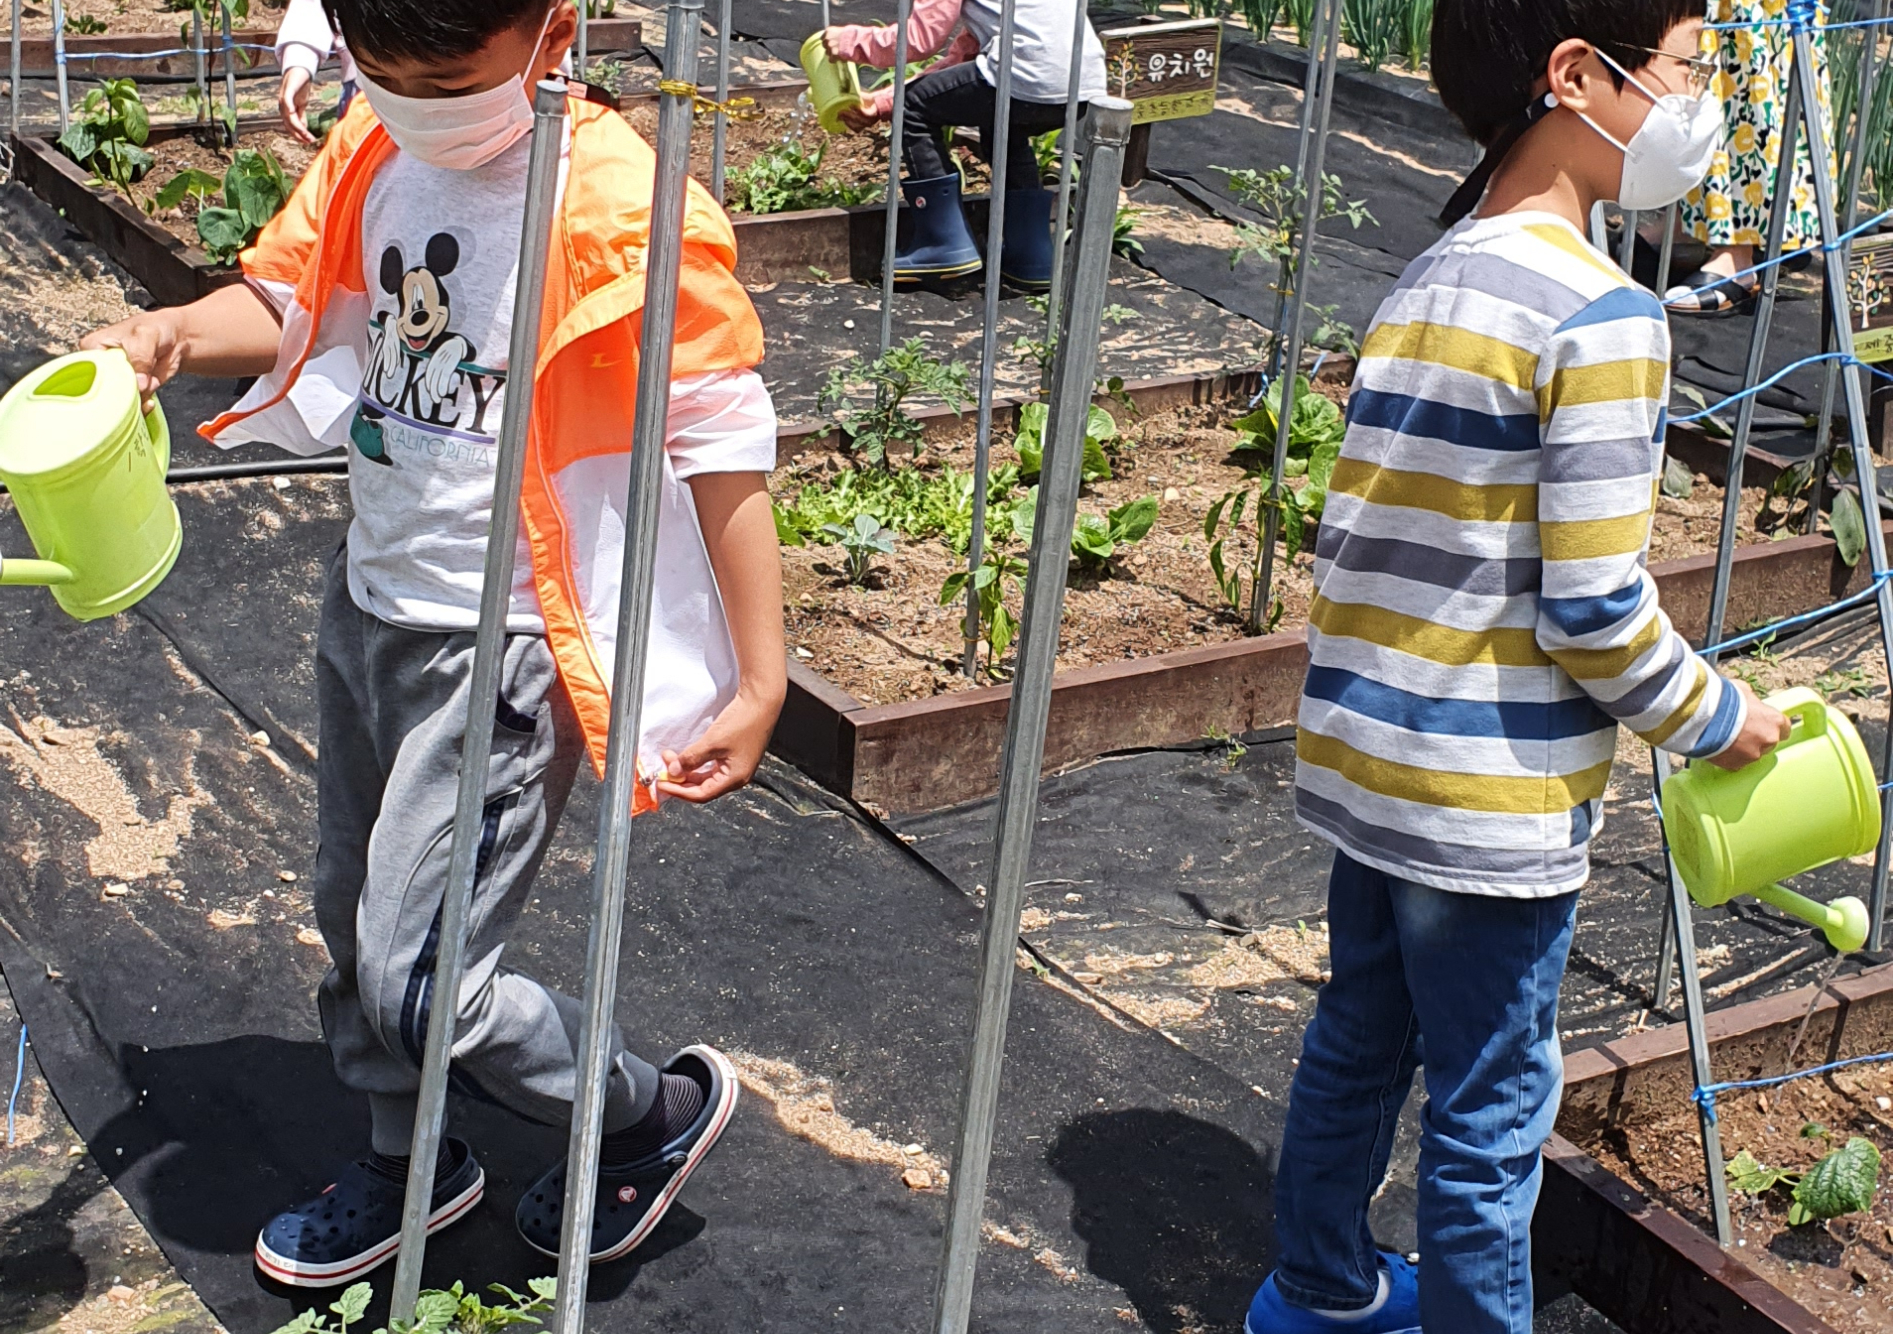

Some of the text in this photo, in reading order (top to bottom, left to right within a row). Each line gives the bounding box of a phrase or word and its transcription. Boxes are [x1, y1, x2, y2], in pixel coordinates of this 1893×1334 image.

[1147, 48, 1215, 83] 유치원
[361, 327, 508, 434] ICKEY
[390, 425, 491, 468] CALIFORNIA
